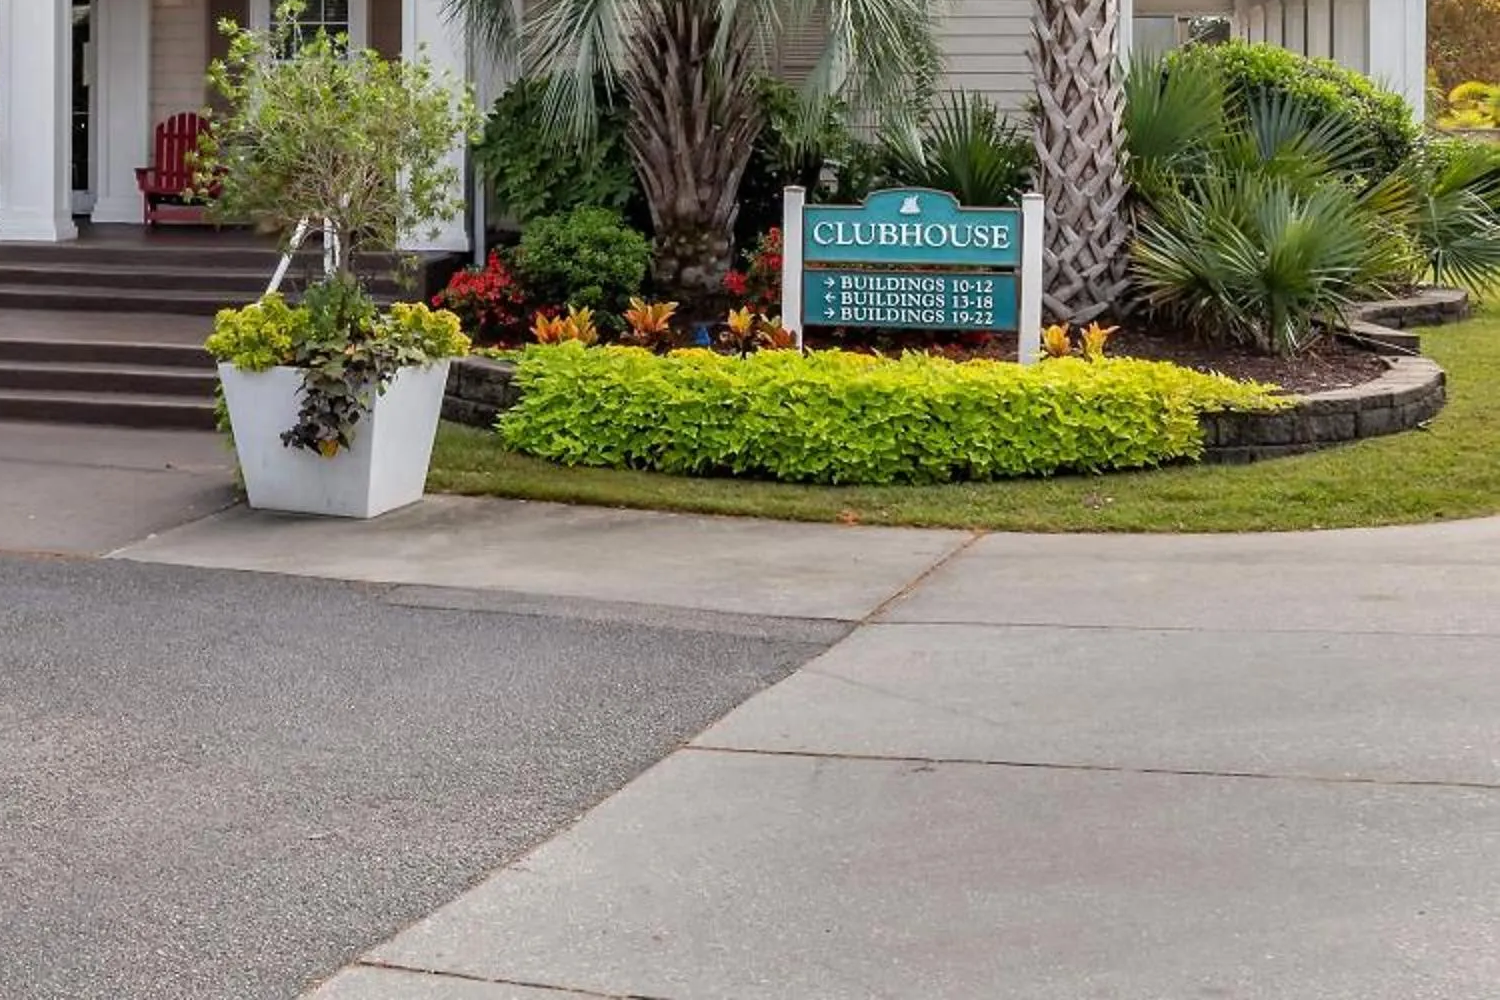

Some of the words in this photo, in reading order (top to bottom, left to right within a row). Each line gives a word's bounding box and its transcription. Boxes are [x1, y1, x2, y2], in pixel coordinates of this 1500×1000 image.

[813, 221, 1011, 249] CLUBHOUSE
[841, 275, 945, 292] BUILDINGS
[952, 279, 993, 293] 10-12
[841, 292, 945, 308] BUILDINGS
[952, 295, 993, 309] 13-18
[841, 307, 945, 323] BUILDINGS
[952, 311, 994, 325] 19-22
